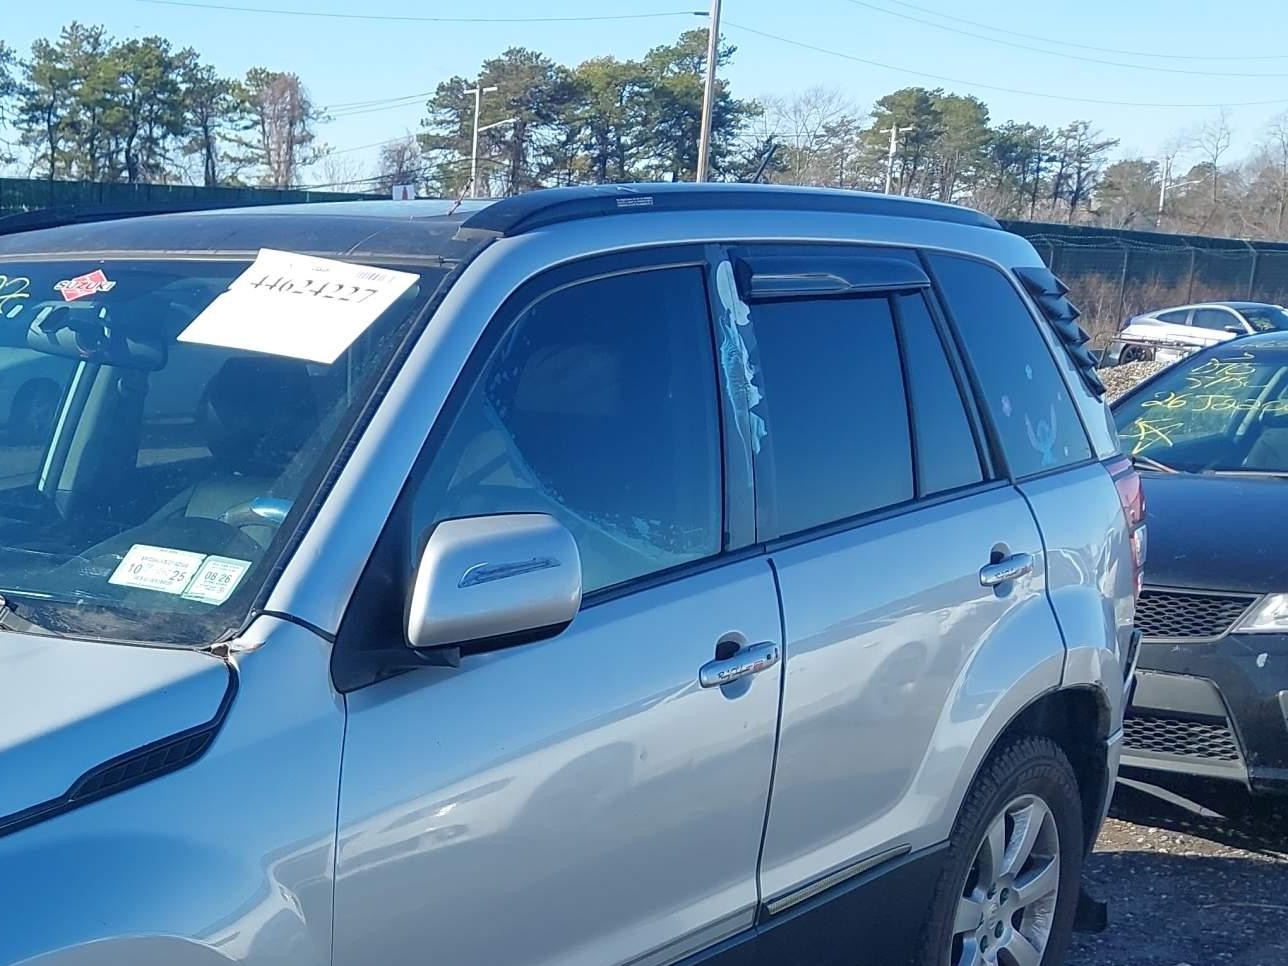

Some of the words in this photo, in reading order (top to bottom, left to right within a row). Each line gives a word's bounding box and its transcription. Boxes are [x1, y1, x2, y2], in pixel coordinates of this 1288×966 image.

[54, 279, 117, 291] SUZUKI
[127, 563, 143, 574] 10
[169, 570, 187, 582] 25
